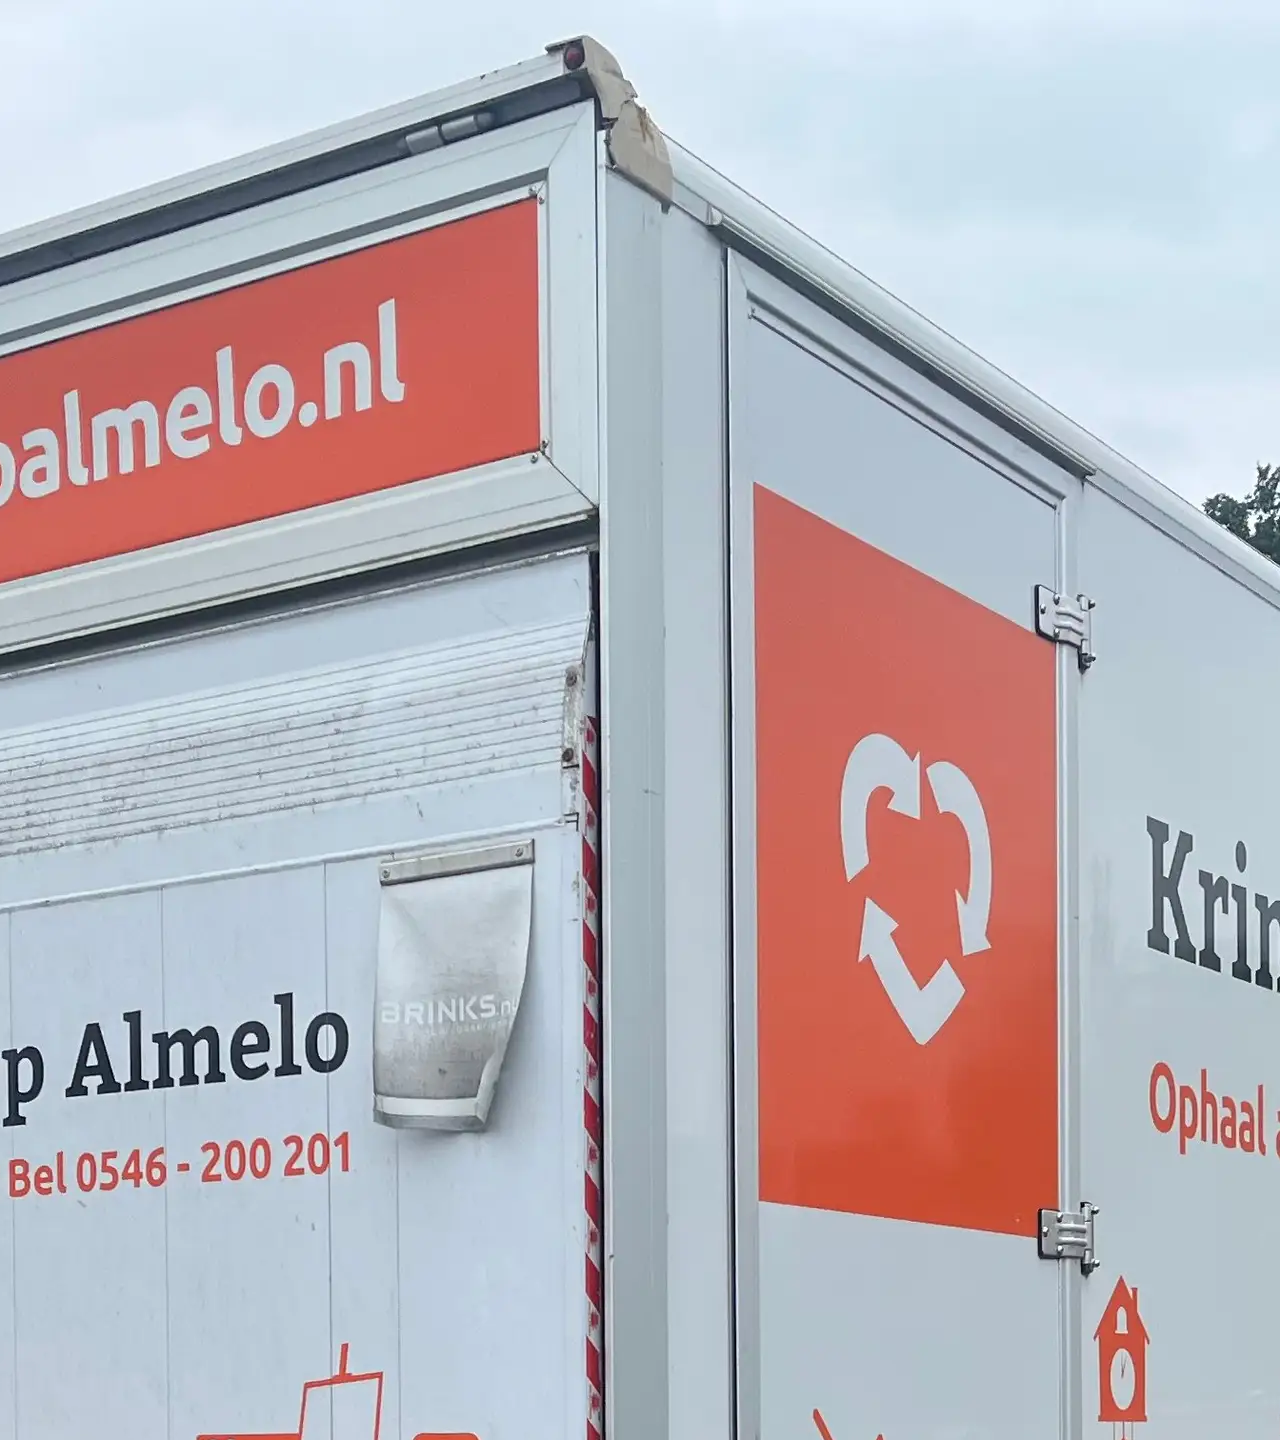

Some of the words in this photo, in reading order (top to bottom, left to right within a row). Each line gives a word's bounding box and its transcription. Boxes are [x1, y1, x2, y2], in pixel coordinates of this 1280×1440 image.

[65, 992, 350, 1098] Almelo
[1148, 1061, 1267, 1155] Ophaal
[8, 1151, 66, 1198] Bel
[76, 1146, 168, 1192] 0546
[201, 1137, 272, 1183] 200
[283, 1131, 351, 1177] 201
